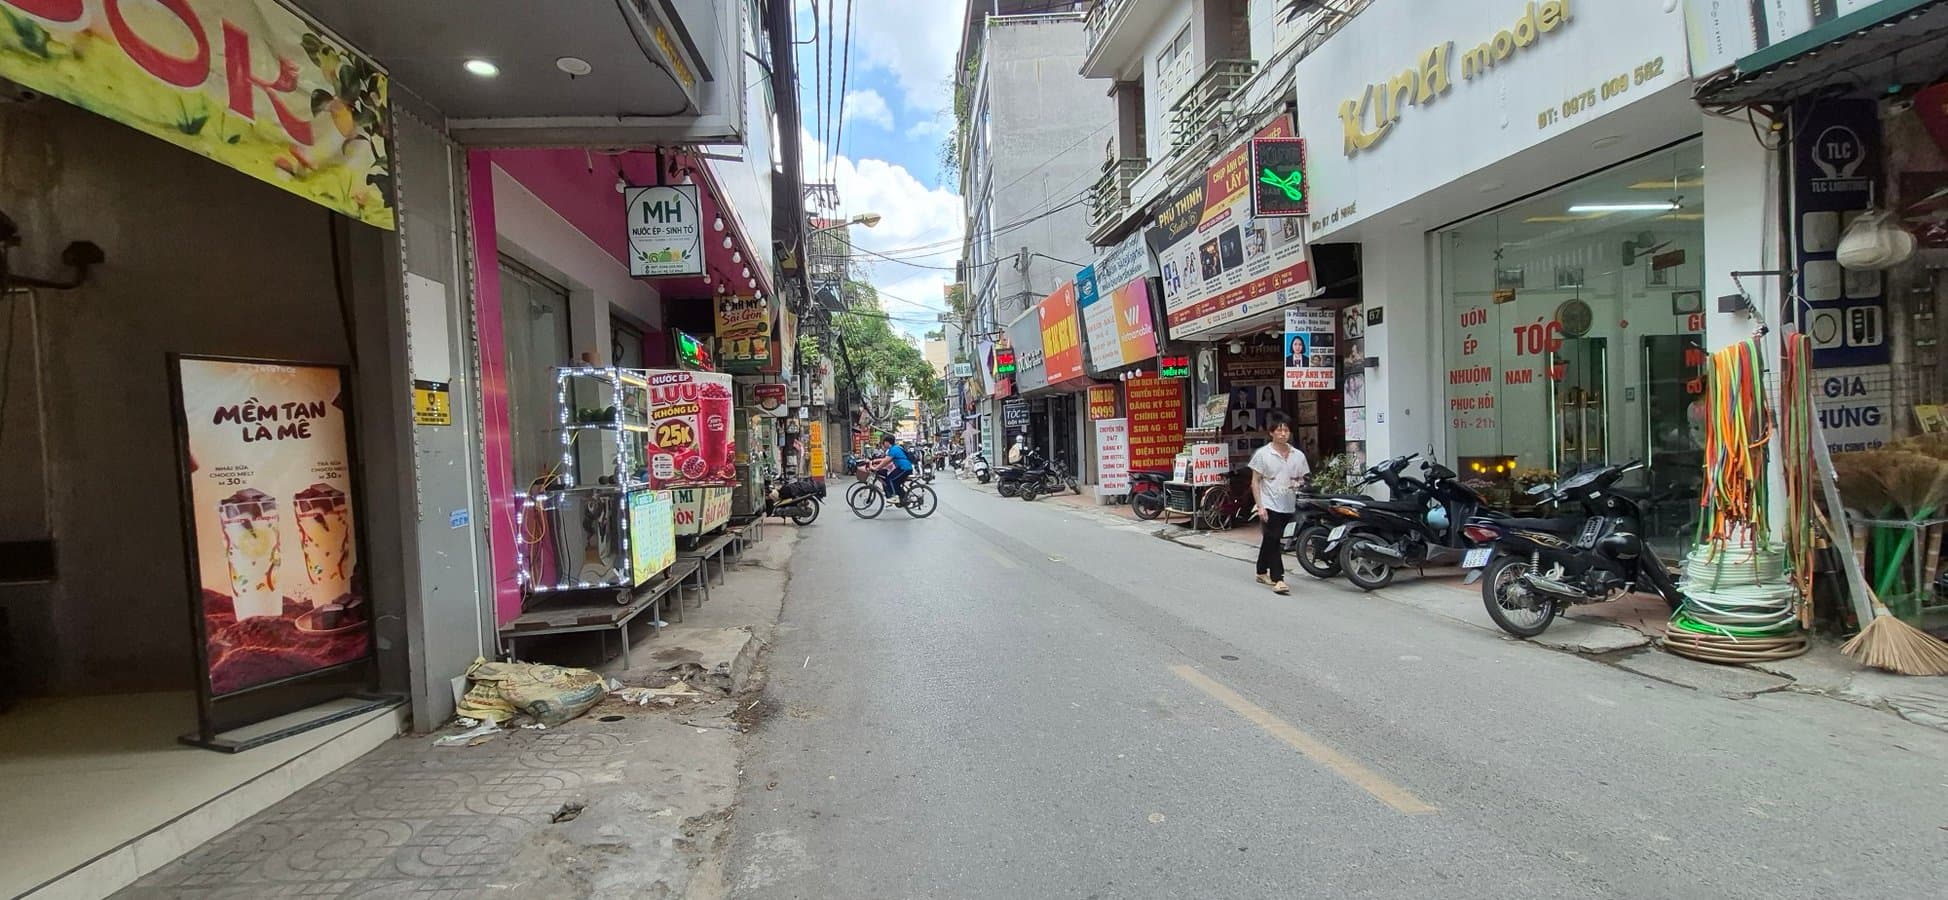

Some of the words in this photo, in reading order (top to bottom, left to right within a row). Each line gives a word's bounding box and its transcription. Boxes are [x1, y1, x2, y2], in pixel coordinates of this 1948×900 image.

[1562, 88, 1595, 118] 0975
[1601, 74, 1629, 101] 009
[1633, 56, 1664, 85] 582
[1827, 143, 1850, 159] TLC
[1812, 182, 1827, 192] TLC
[643, 201, 681, 224] MH
[1158, 202, 1175, 229] PHÚ
[1176, 187, 1203, 213] THỊNH
[1461, 305, 1487, 328] UỐN
[1464, 334, 1477, 355] ÉP
[1513, 316, 1564, 356] TÓC
[652, 374, 677, 384] NƯỚC
[679, 373, 689, 381] ÉP
[1450, 365, 1492, 386] NHUỘM
[1505, 369, 1532, 384] NAM
[651, 383, 698, 405] LỰU
[1824, 376, 1866, 397] GIA
[213, 397, 278, 425] MỀM
[281, 400, 326, 420] TAN
[1091, 406, 1115, 419] 9999
[1451, 398, 1476, 414] PHỤC
[1478, 390, 1494, 409] HỒI
[242, 423, 272, 442] LÀ
[277, 419, 311, 440] MÊ
[1453, 418, 1467, 429] 9h
[659, 424, 691, 448] 25K
[1200, 446, 1220, 456] CHỤP
[1195, 458, 1211, 469] ẢNH
[1214, 457, 1228, 468] THẺ
[1195, 472, 1208, 483] LẤY
